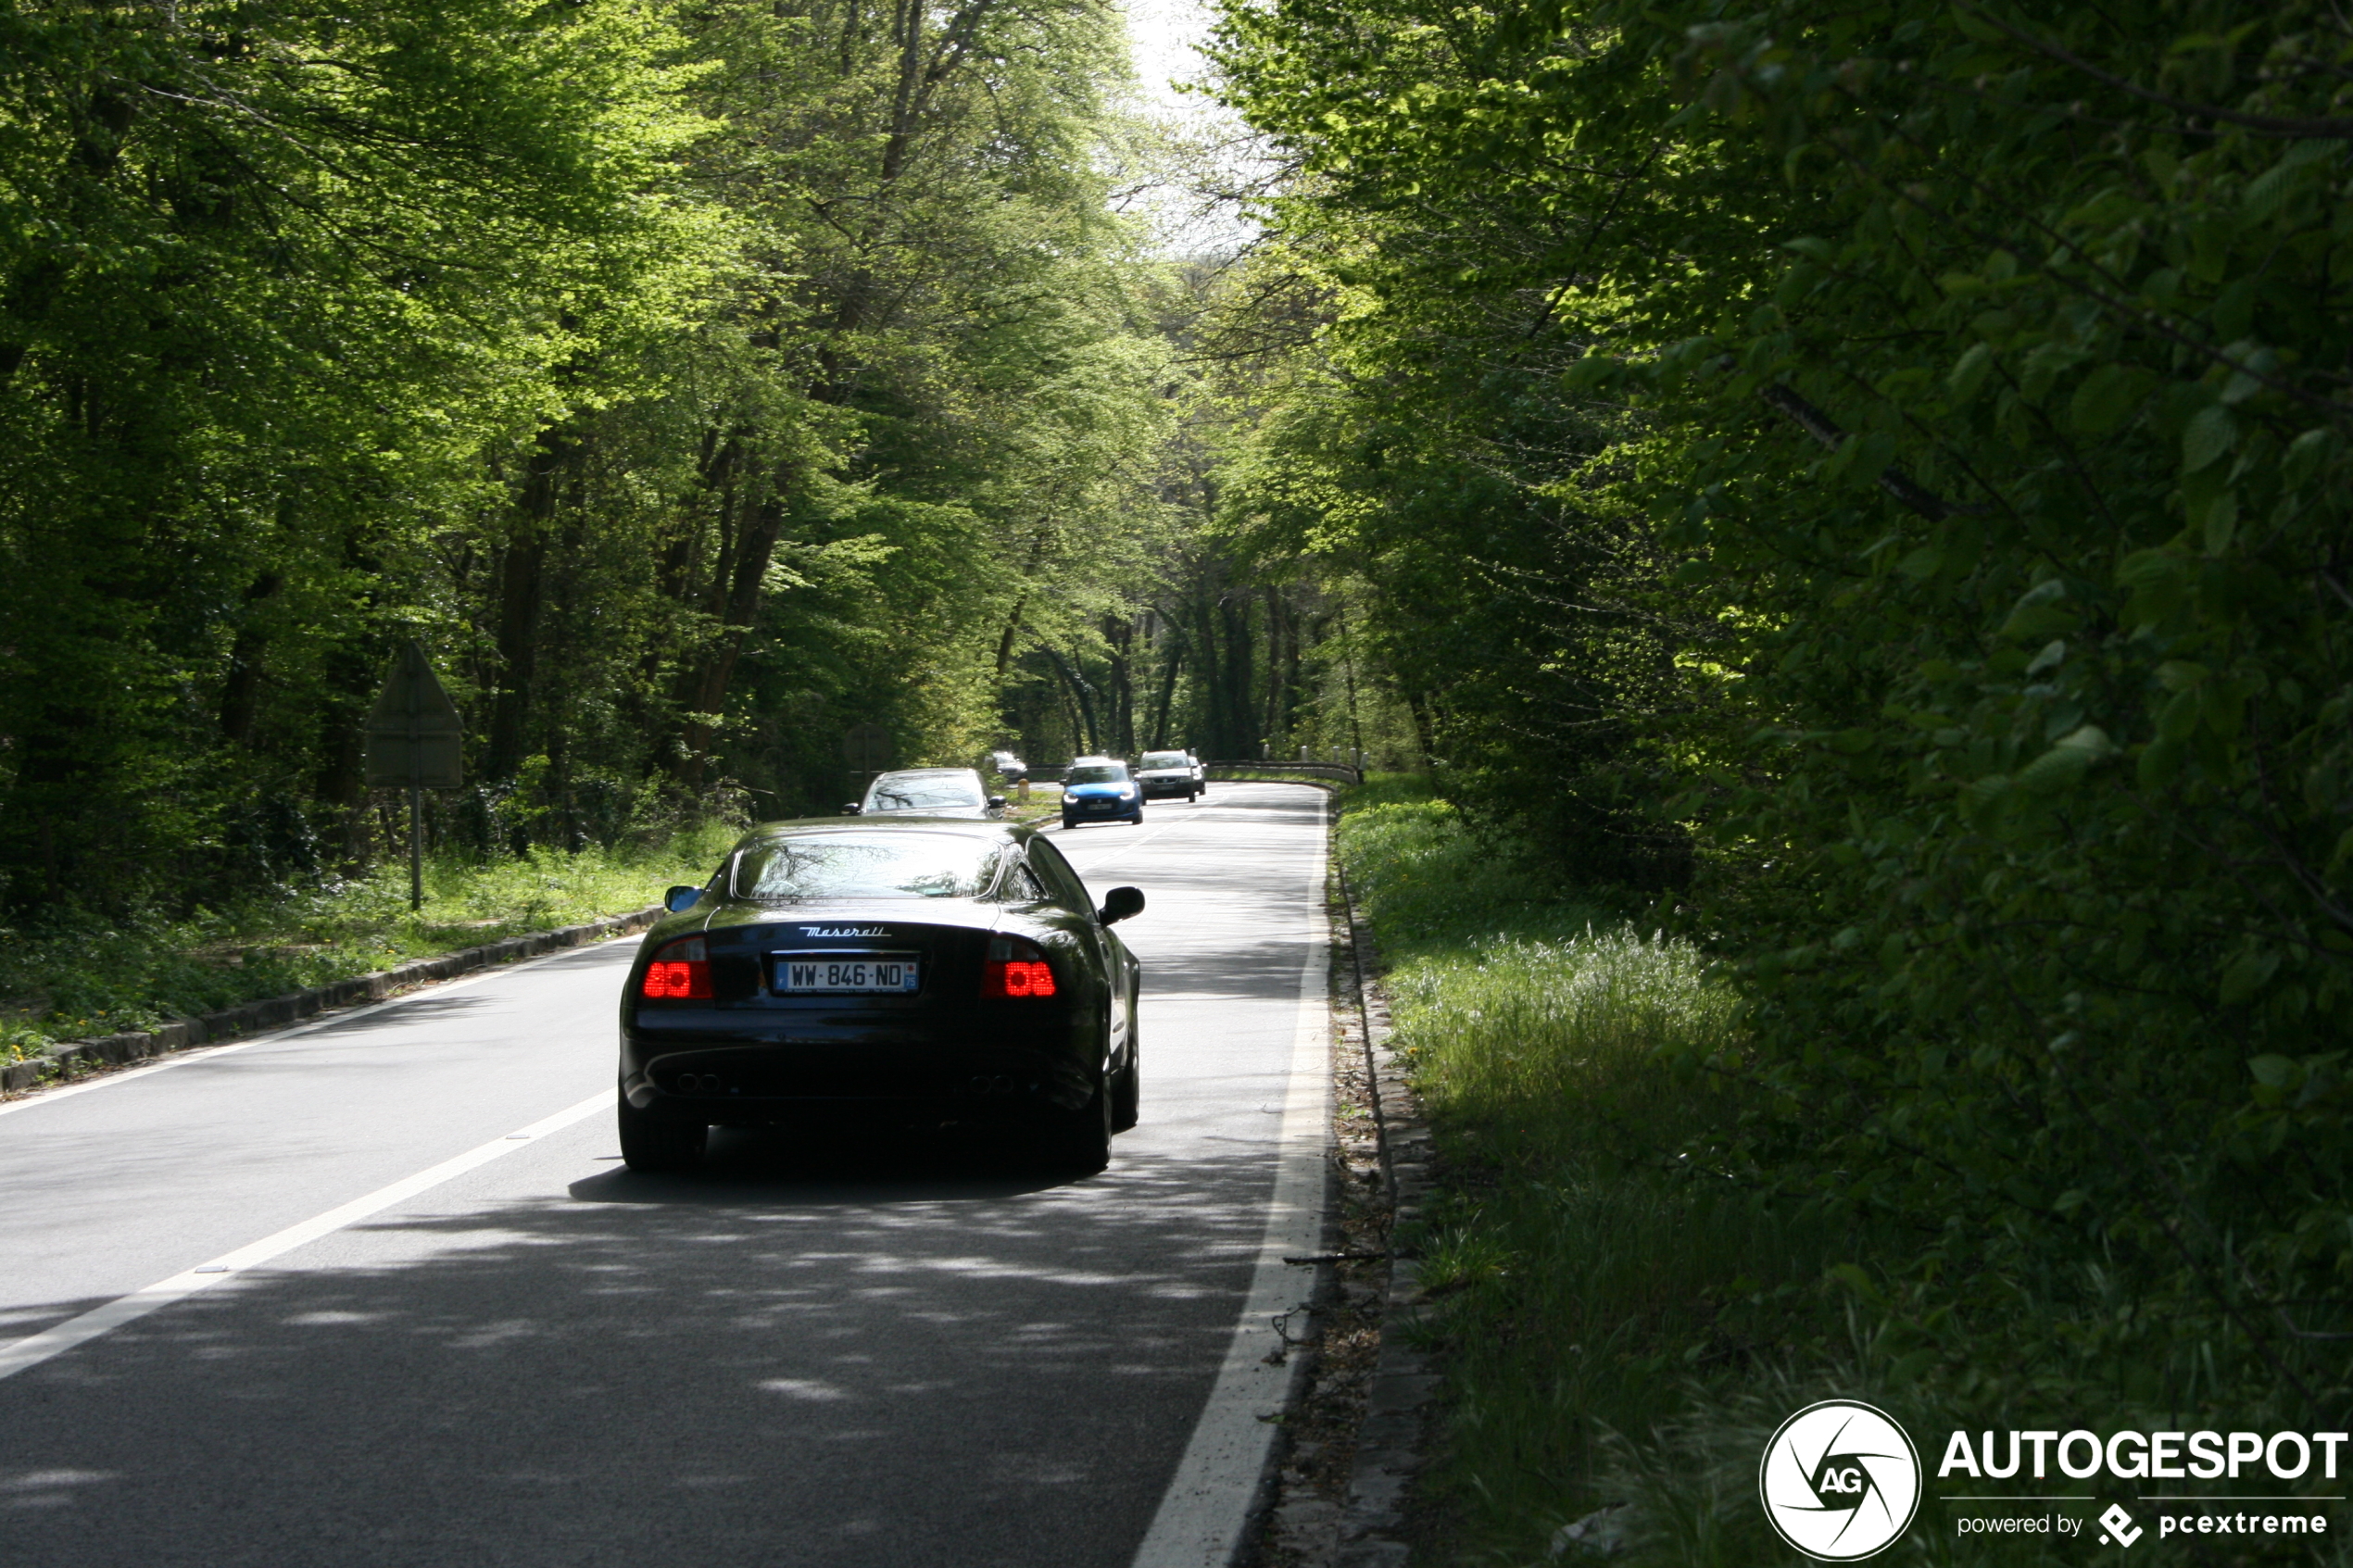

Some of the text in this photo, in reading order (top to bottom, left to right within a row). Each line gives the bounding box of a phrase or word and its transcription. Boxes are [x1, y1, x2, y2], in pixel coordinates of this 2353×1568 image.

[799, 926, 892, 937] Maserati
[792, 965, 900, 985] WW-846-ND
[905, 977, 916, 986] 75
